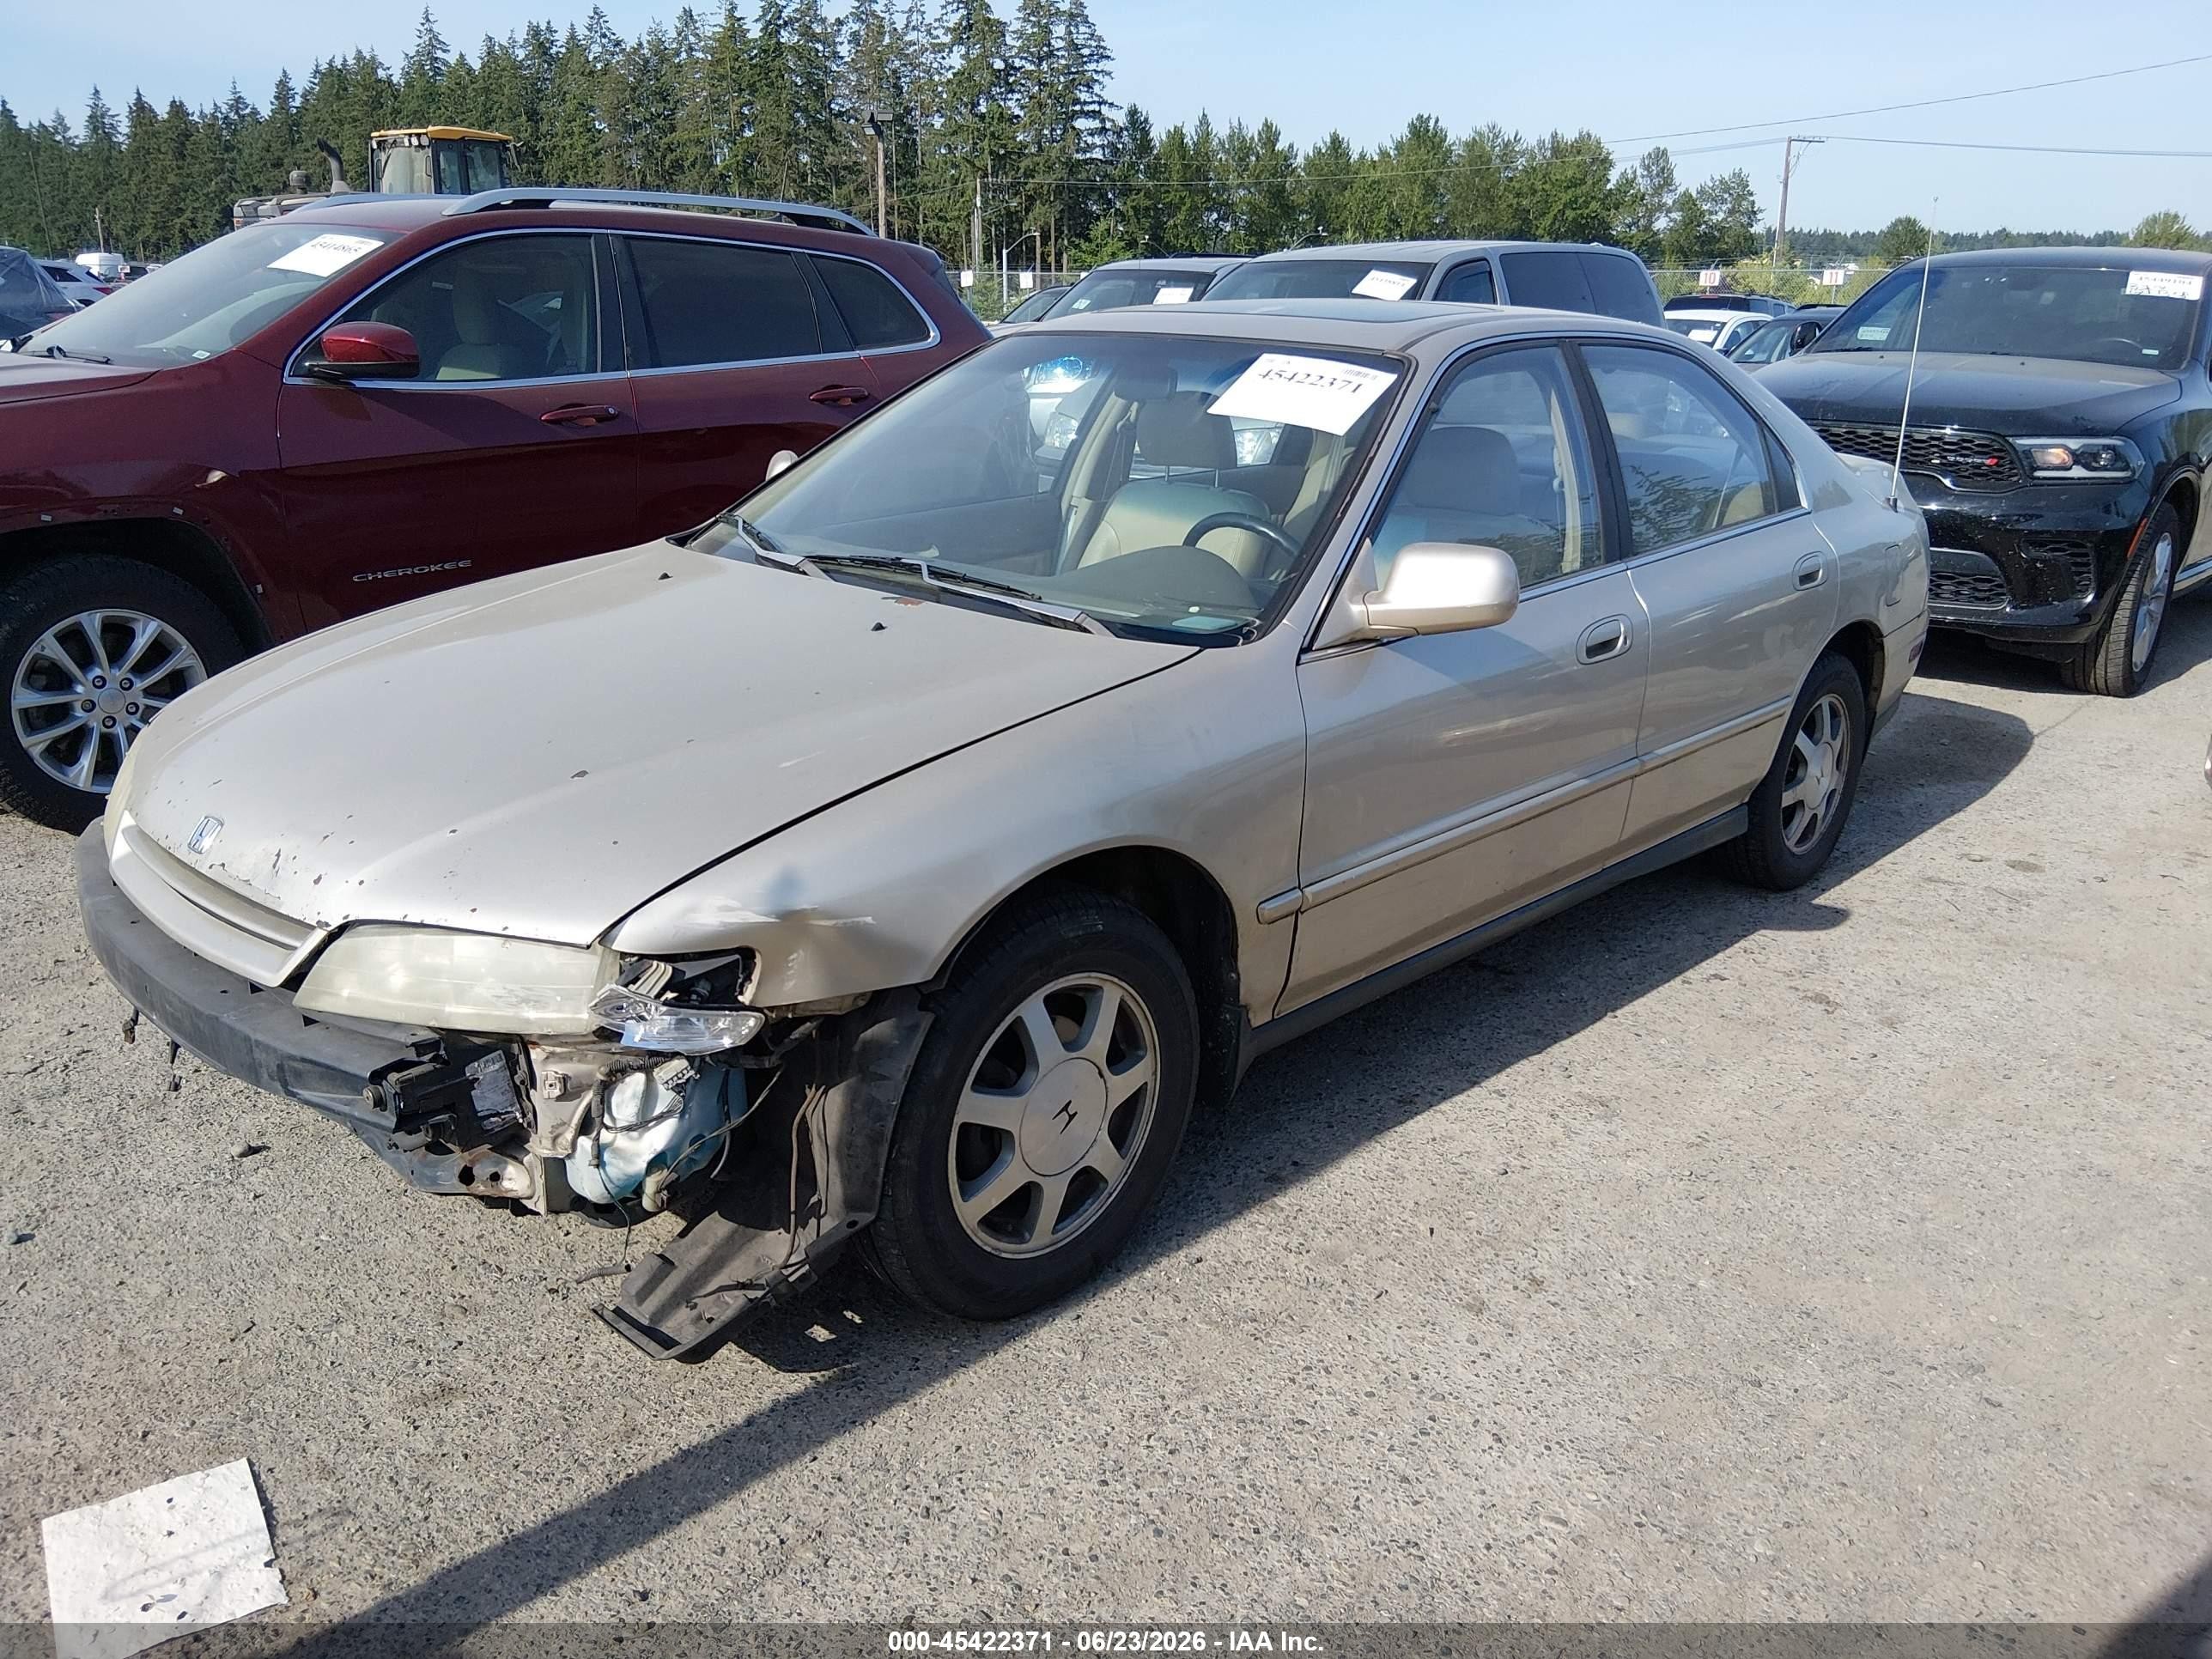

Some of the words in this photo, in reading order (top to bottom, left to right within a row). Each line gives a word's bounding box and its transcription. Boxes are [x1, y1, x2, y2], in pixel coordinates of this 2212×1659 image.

[1704, 271, 1717, 284] 10
[1829, 270, 1839, 284] 11
[1258, 368, 1364, 394] 45422371
[352, 559, 472, 582] CHEROKEE
